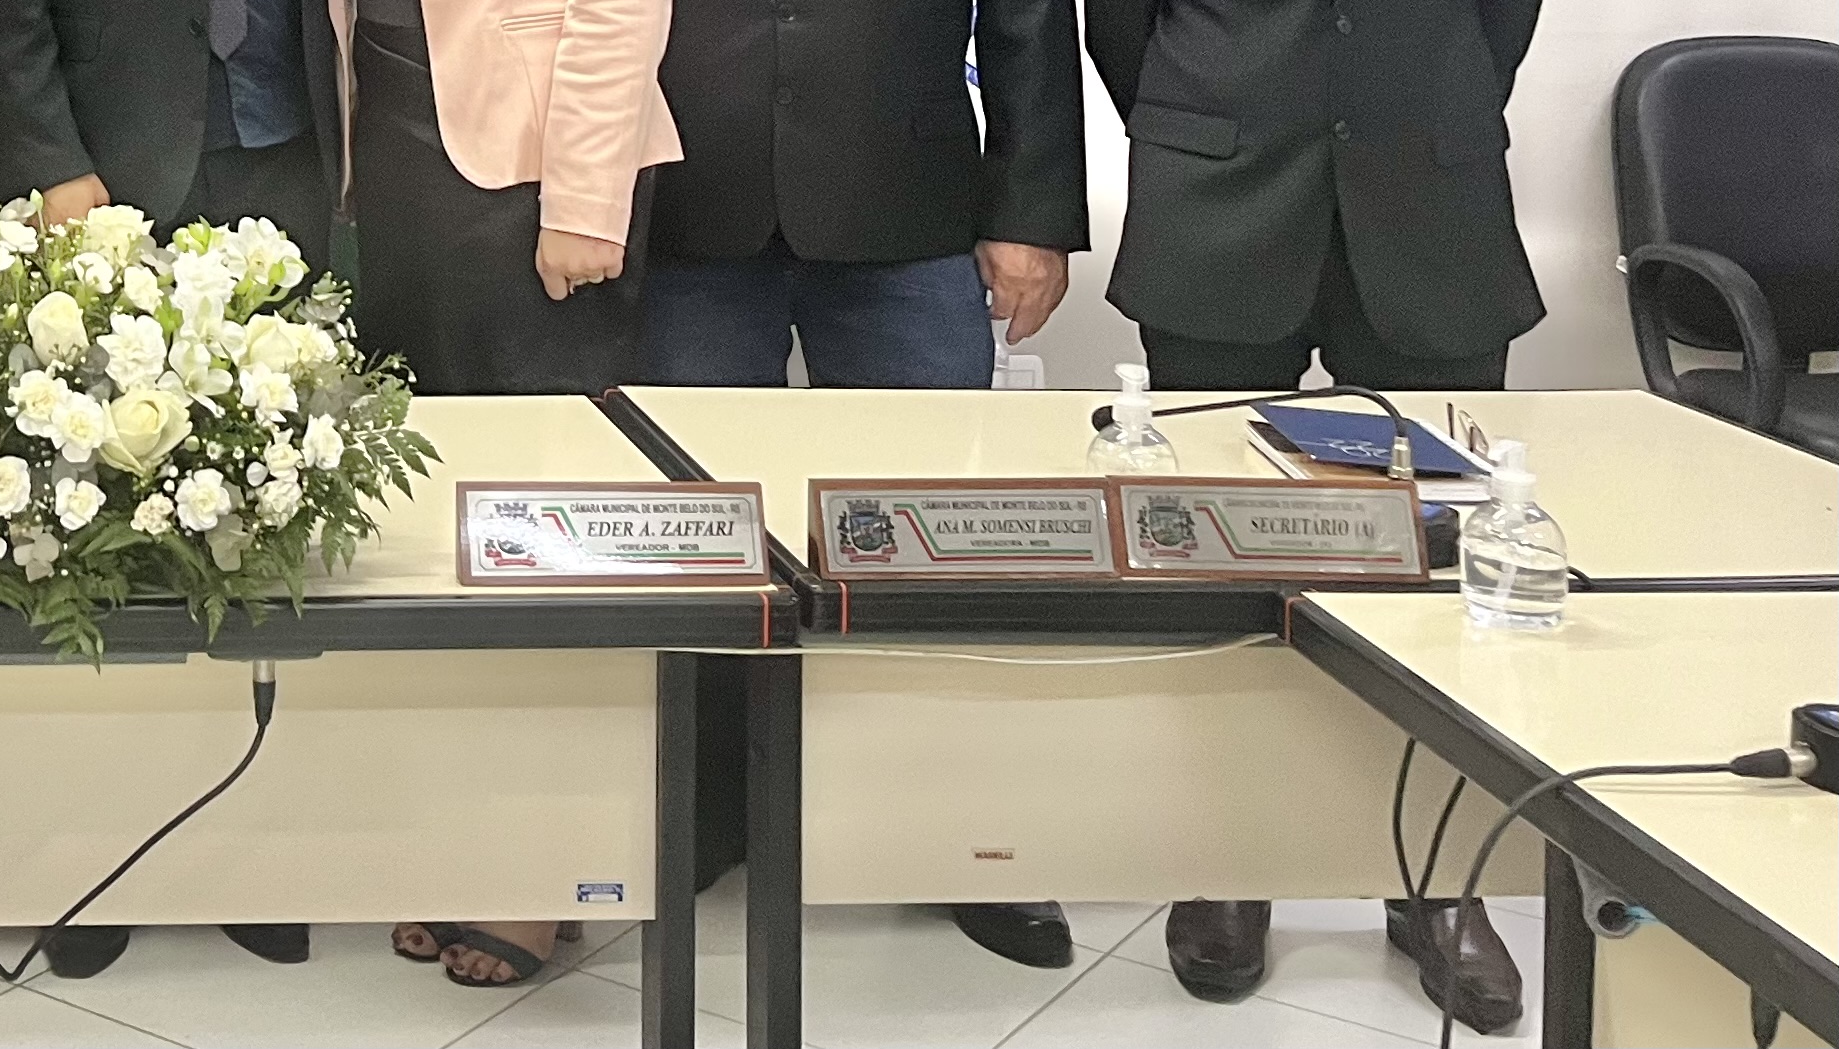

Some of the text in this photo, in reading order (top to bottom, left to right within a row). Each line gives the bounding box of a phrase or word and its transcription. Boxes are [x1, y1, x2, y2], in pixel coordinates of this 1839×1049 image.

[588, 521, 735, 537] EDER A. ZAFFARI
[934, 519, 960, 534] ANA
[1039, 519, 1092, 534] BRUSCHI
[1250, 514, 1349, 536] SECRETÁRIO
